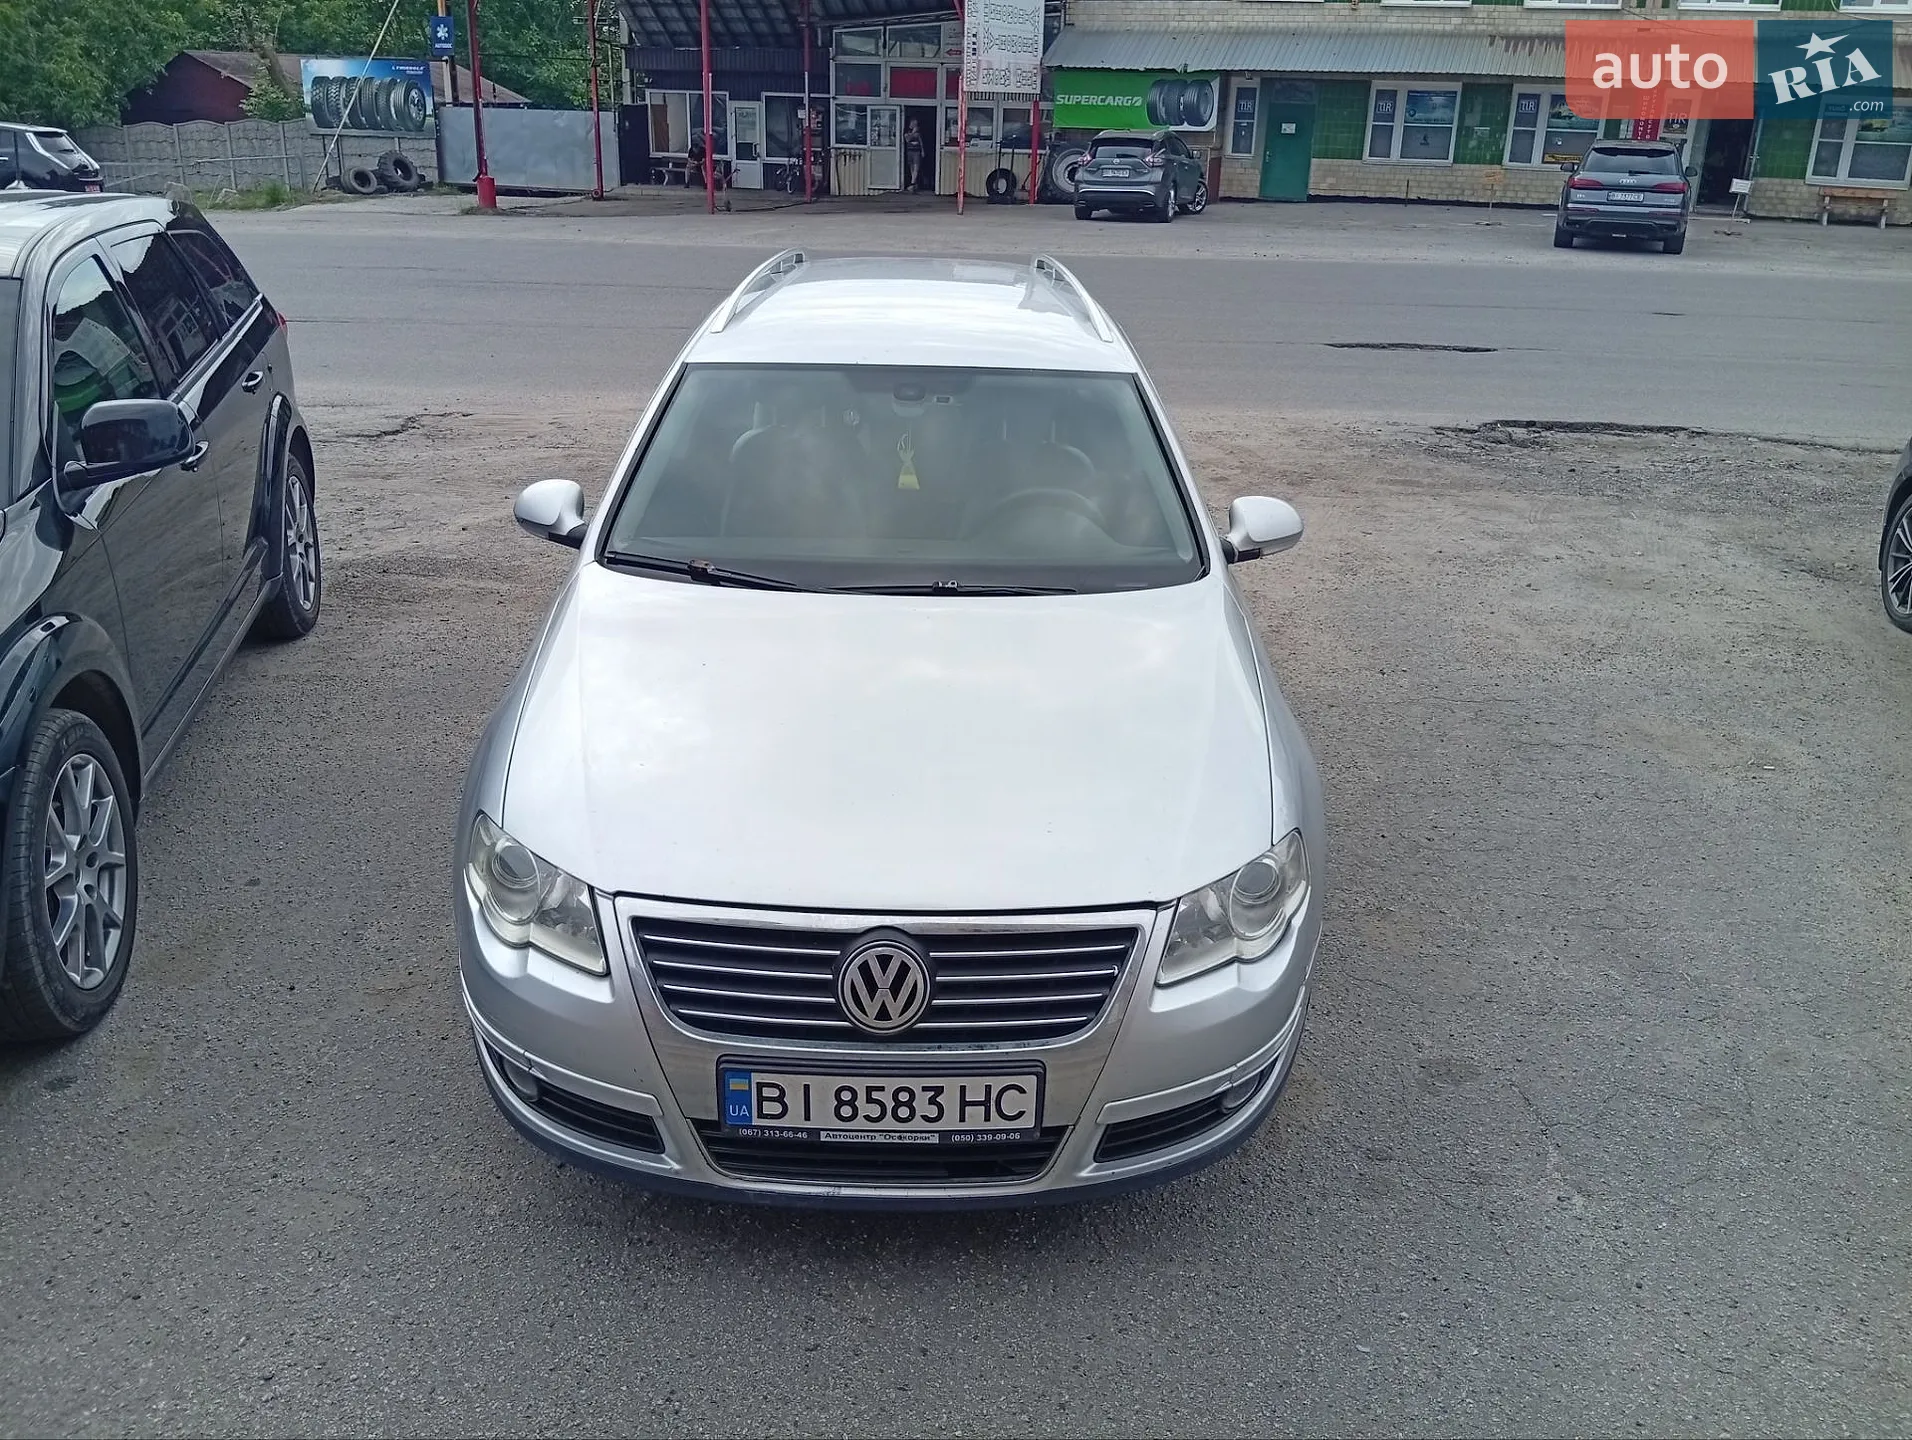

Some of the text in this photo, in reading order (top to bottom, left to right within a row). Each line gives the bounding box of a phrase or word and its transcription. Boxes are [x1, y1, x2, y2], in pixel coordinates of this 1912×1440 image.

[1055, 94, 1143, 107] SUPERCARGO
[1521, 101, 1535, 111] TIR
[1378, 102, 1392, 112] TIR
[1668, 112, 1687, 124] TIR
[756, 1081, 1027, 1124] BI 8583 HC
[730, 1104, 749, 1117] UA
[739, 1128, 761, 1137] (067)
[824, 1131, 877, 1141] Автоцентр
[951, 1132, 1021, 1143] (050) 339-09-06
